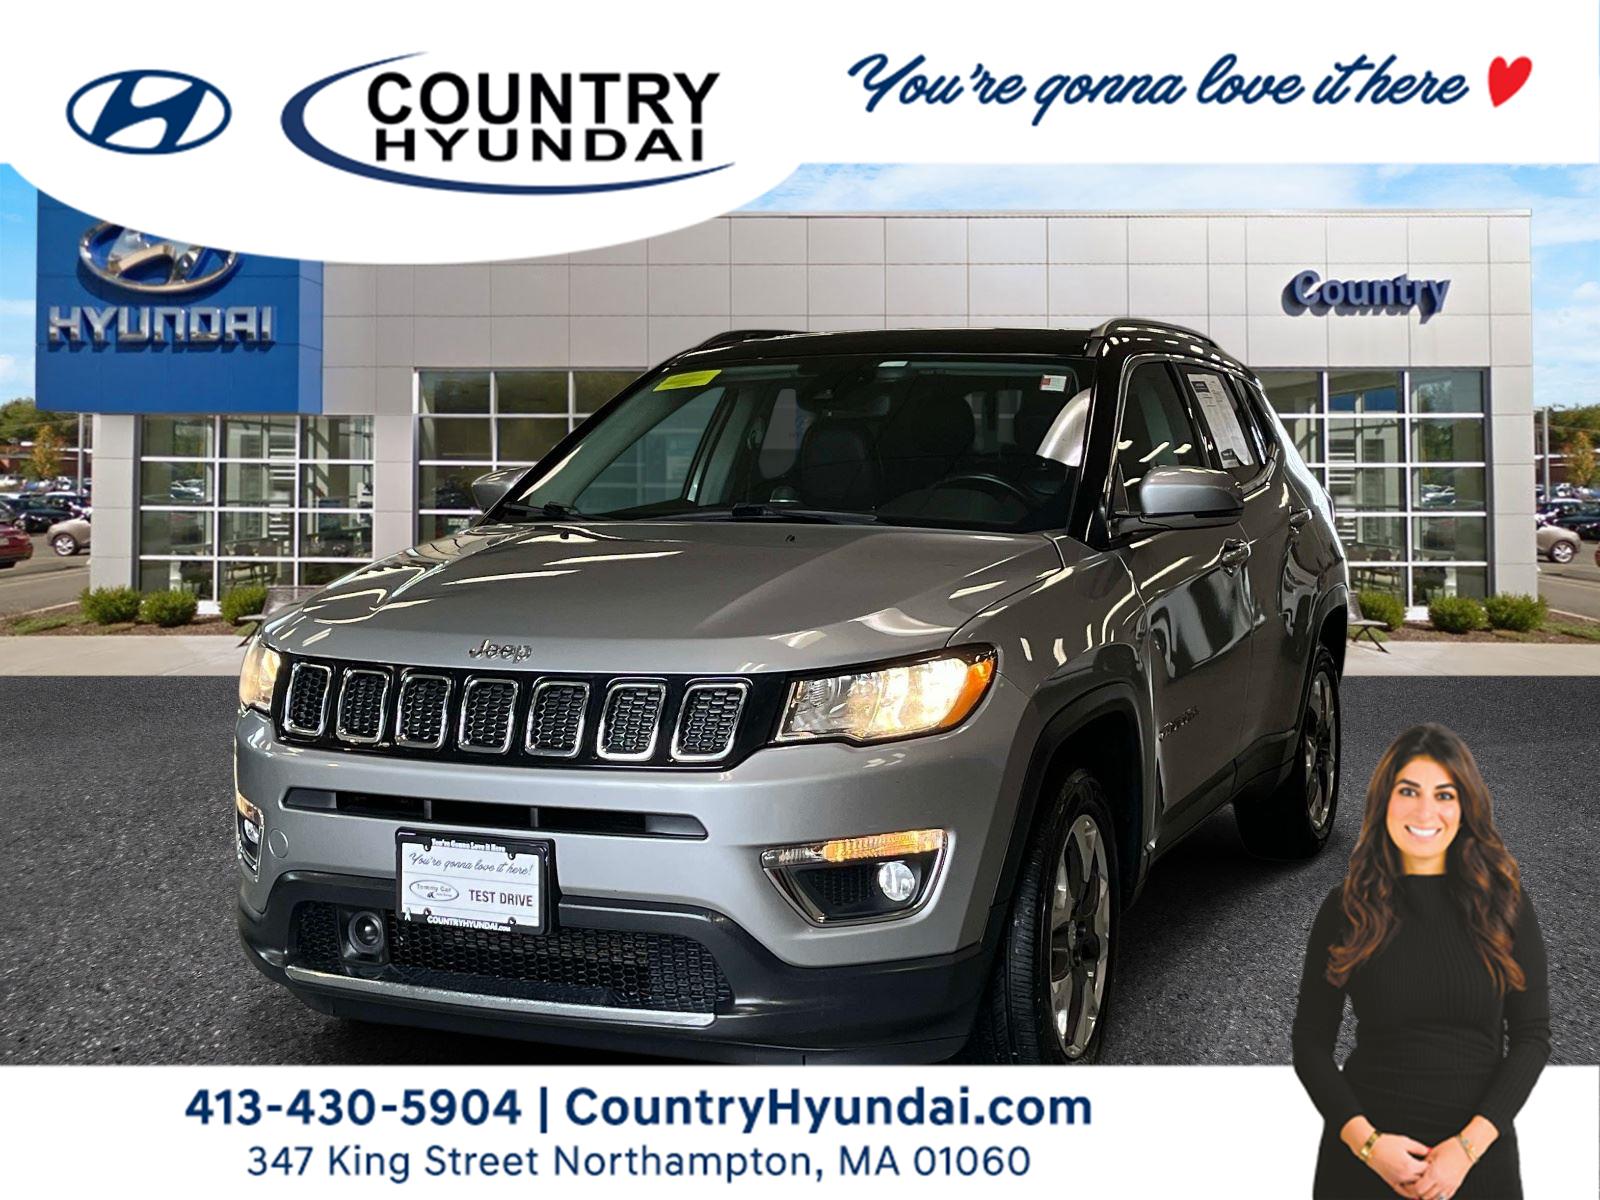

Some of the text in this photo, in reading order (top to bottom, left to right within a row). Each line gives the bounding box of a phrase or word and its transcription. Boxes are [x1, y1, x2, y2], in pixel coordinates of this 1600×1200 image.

[1281, 269, 1452, 325] Country
[48, 305, 275, 346] HYUNDAI
[468, 639, 532, 664] Jeep
[409, 852, 441, 866] You're
[444, 860, 472, 872] gonna
[474, 859, 496, 872] love
[468, 889, 534, 907] TEST DRIVE
